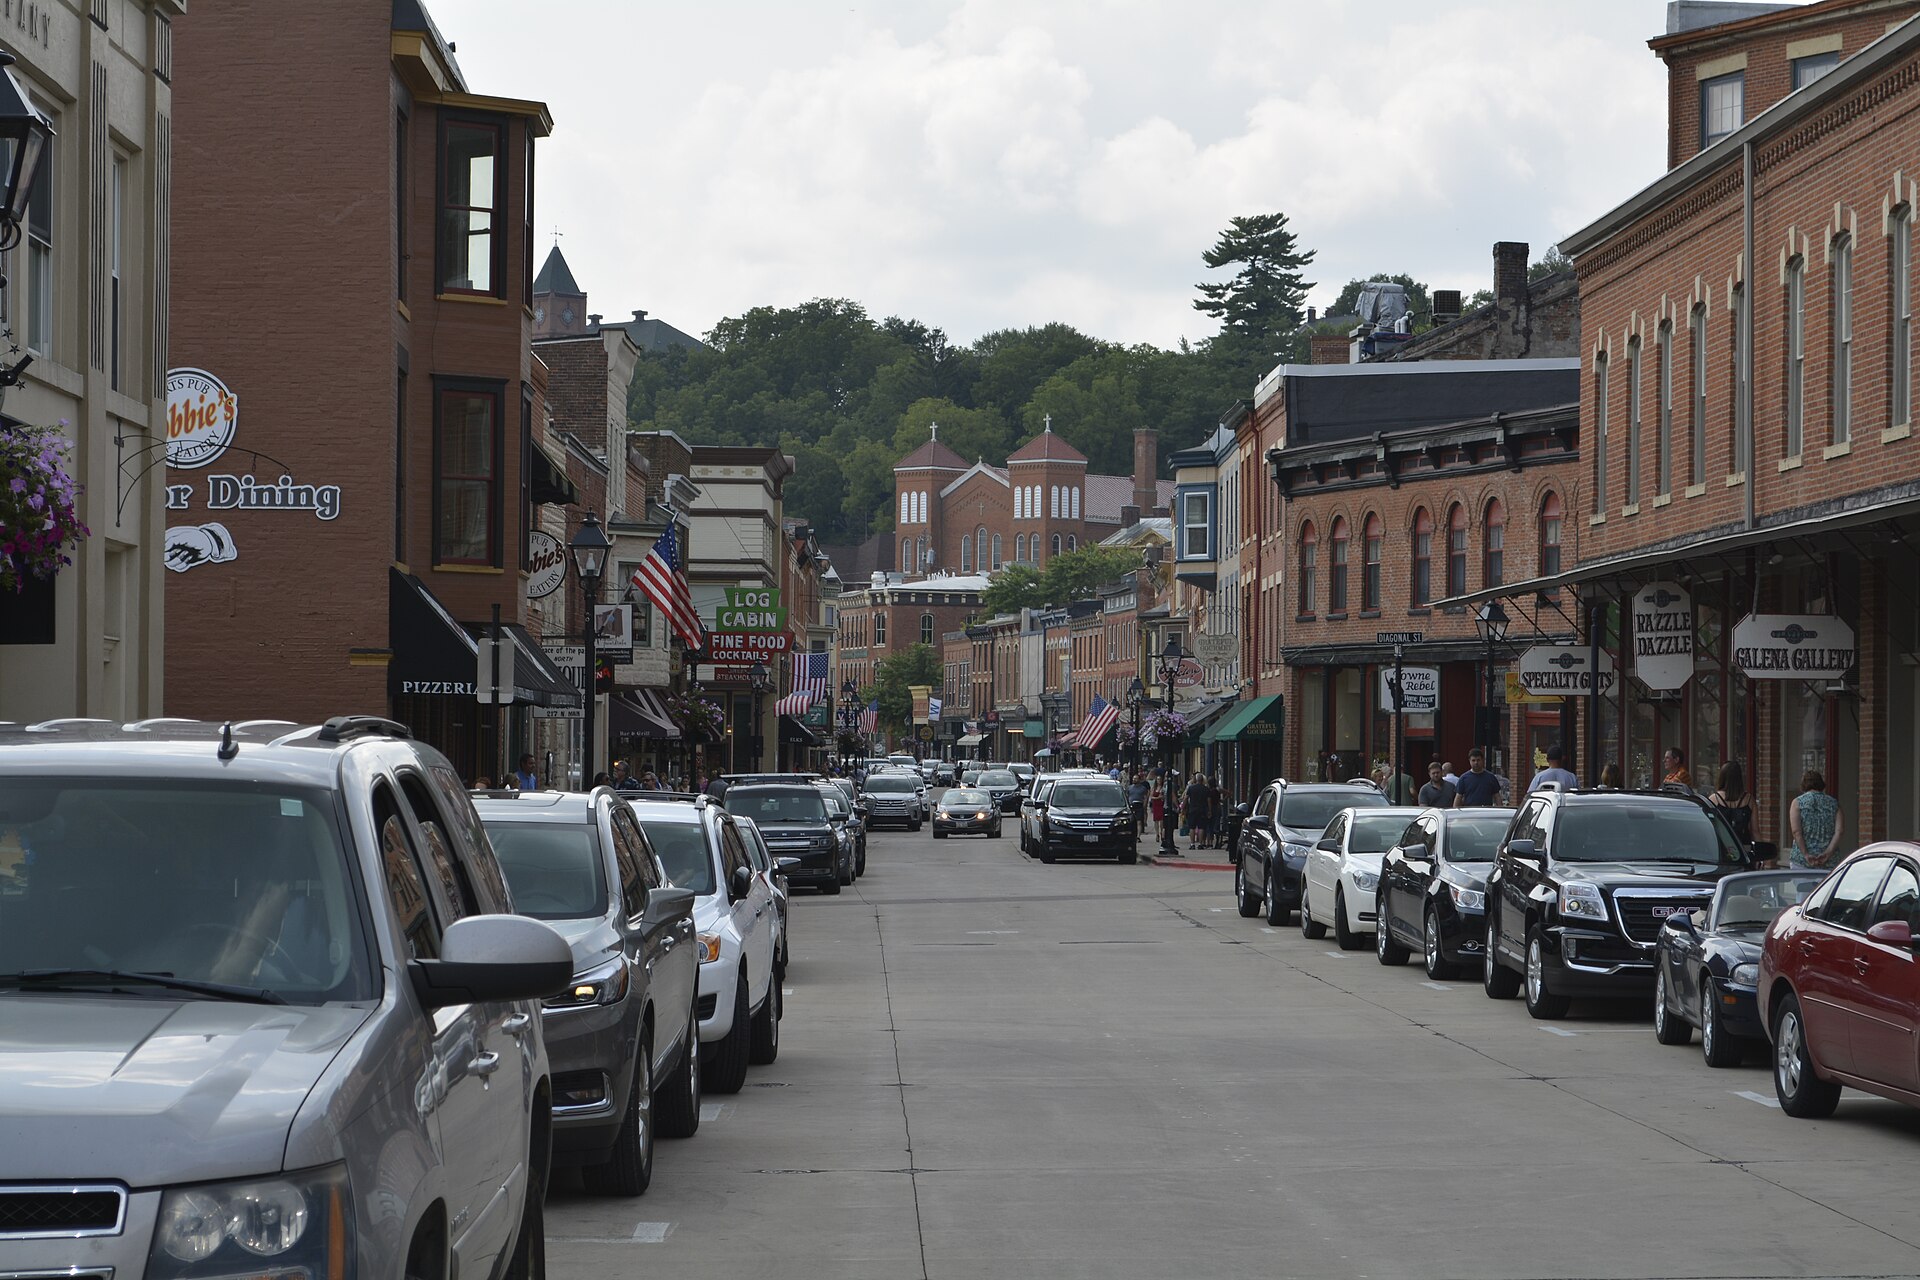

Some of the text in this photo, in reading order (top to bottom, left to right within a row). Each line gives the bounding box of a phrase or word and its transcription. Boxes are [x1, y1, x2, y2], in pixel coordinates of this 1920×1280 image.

[187, 378, 210, 395] PUB
[167, 389, 234, 438] bbie's
[208, 475, 340, 519] Dining
[531, 535, 549, 547] PUB
[530, 570, 560, 594] EATERY
[734, 592, 770, 608] LOG
[722, 611, 777, 628] CABIN
[1636, 611, 1691, 633] RAZZLE
[712, 635, 786, 649] FINE FOOD
[1378, 633, 1422, 643] DIAGONAL ST
[1637, 635, 1692, 656] DAZZLE
[712, 651, 769, 660] COCKTAILS
[1736, 647, 1854, 671] GALENA GALLERY
[1406, 681, 1436, 691] Rebel
[1522, 672, 1580, 690] SPECIALTY
[1580, 672, 1613, 689] GITS
